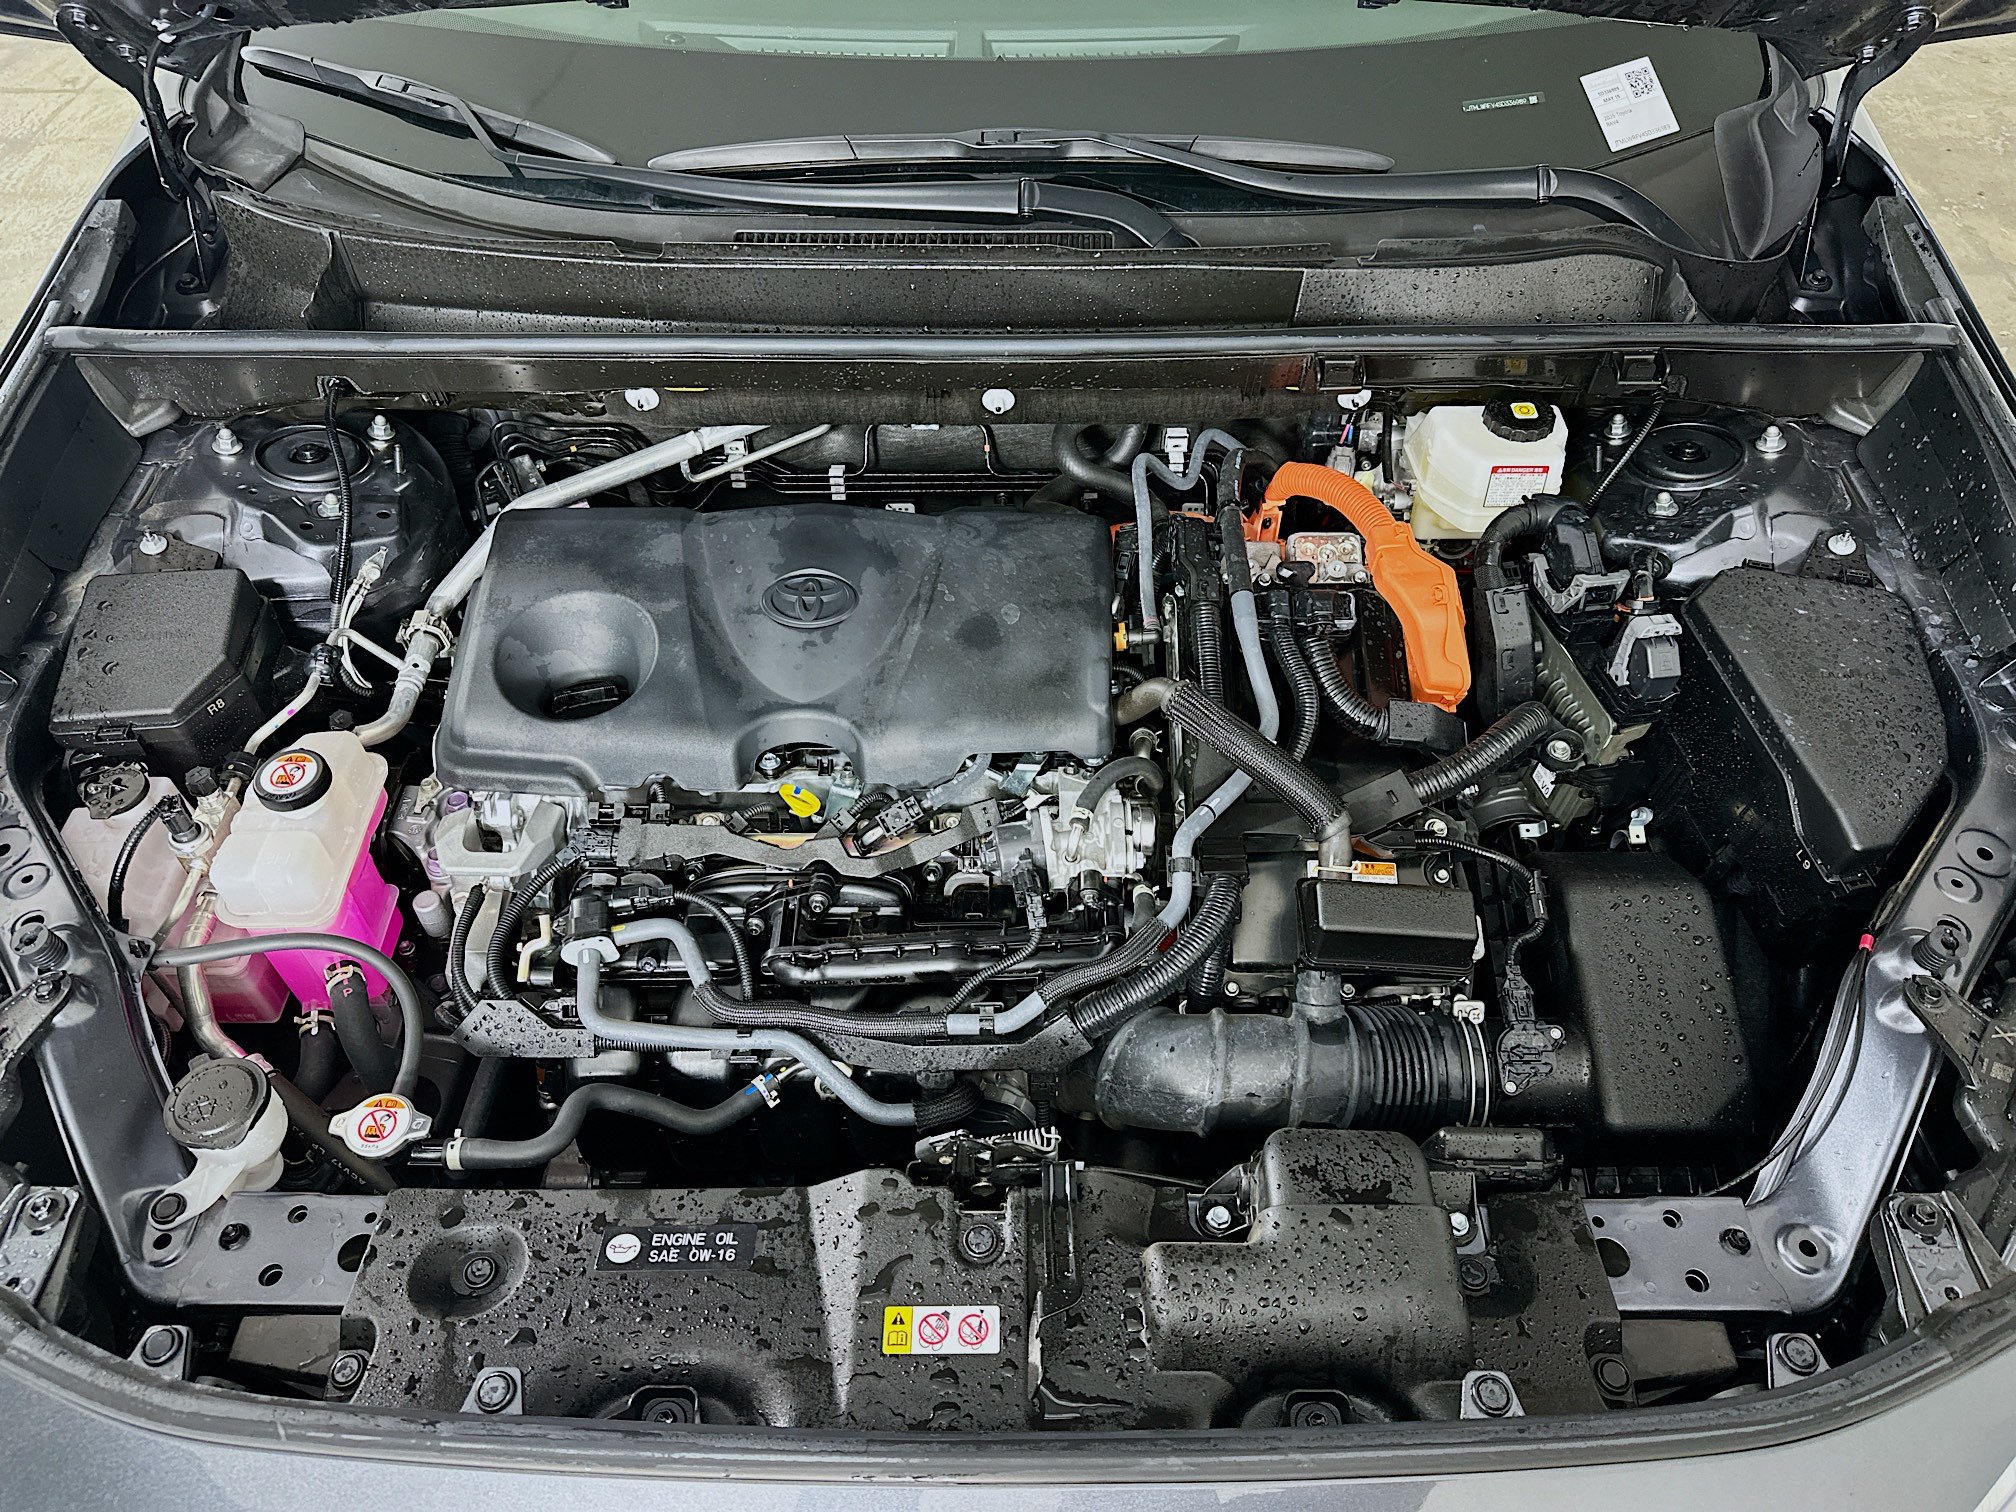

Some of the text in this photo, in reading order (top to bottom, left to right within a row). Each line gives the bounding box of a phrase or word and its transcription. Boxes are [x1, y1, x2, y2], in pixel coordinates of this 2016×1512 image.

[206, 698, 226, 716] R8
[1795, 849, 1811, 870] L9
[342, 987, 353, 998] P
[651, 1232, 739, 1246] ENGINE OIL
[648, 1248, 736, 1263] SAE 0W-16
